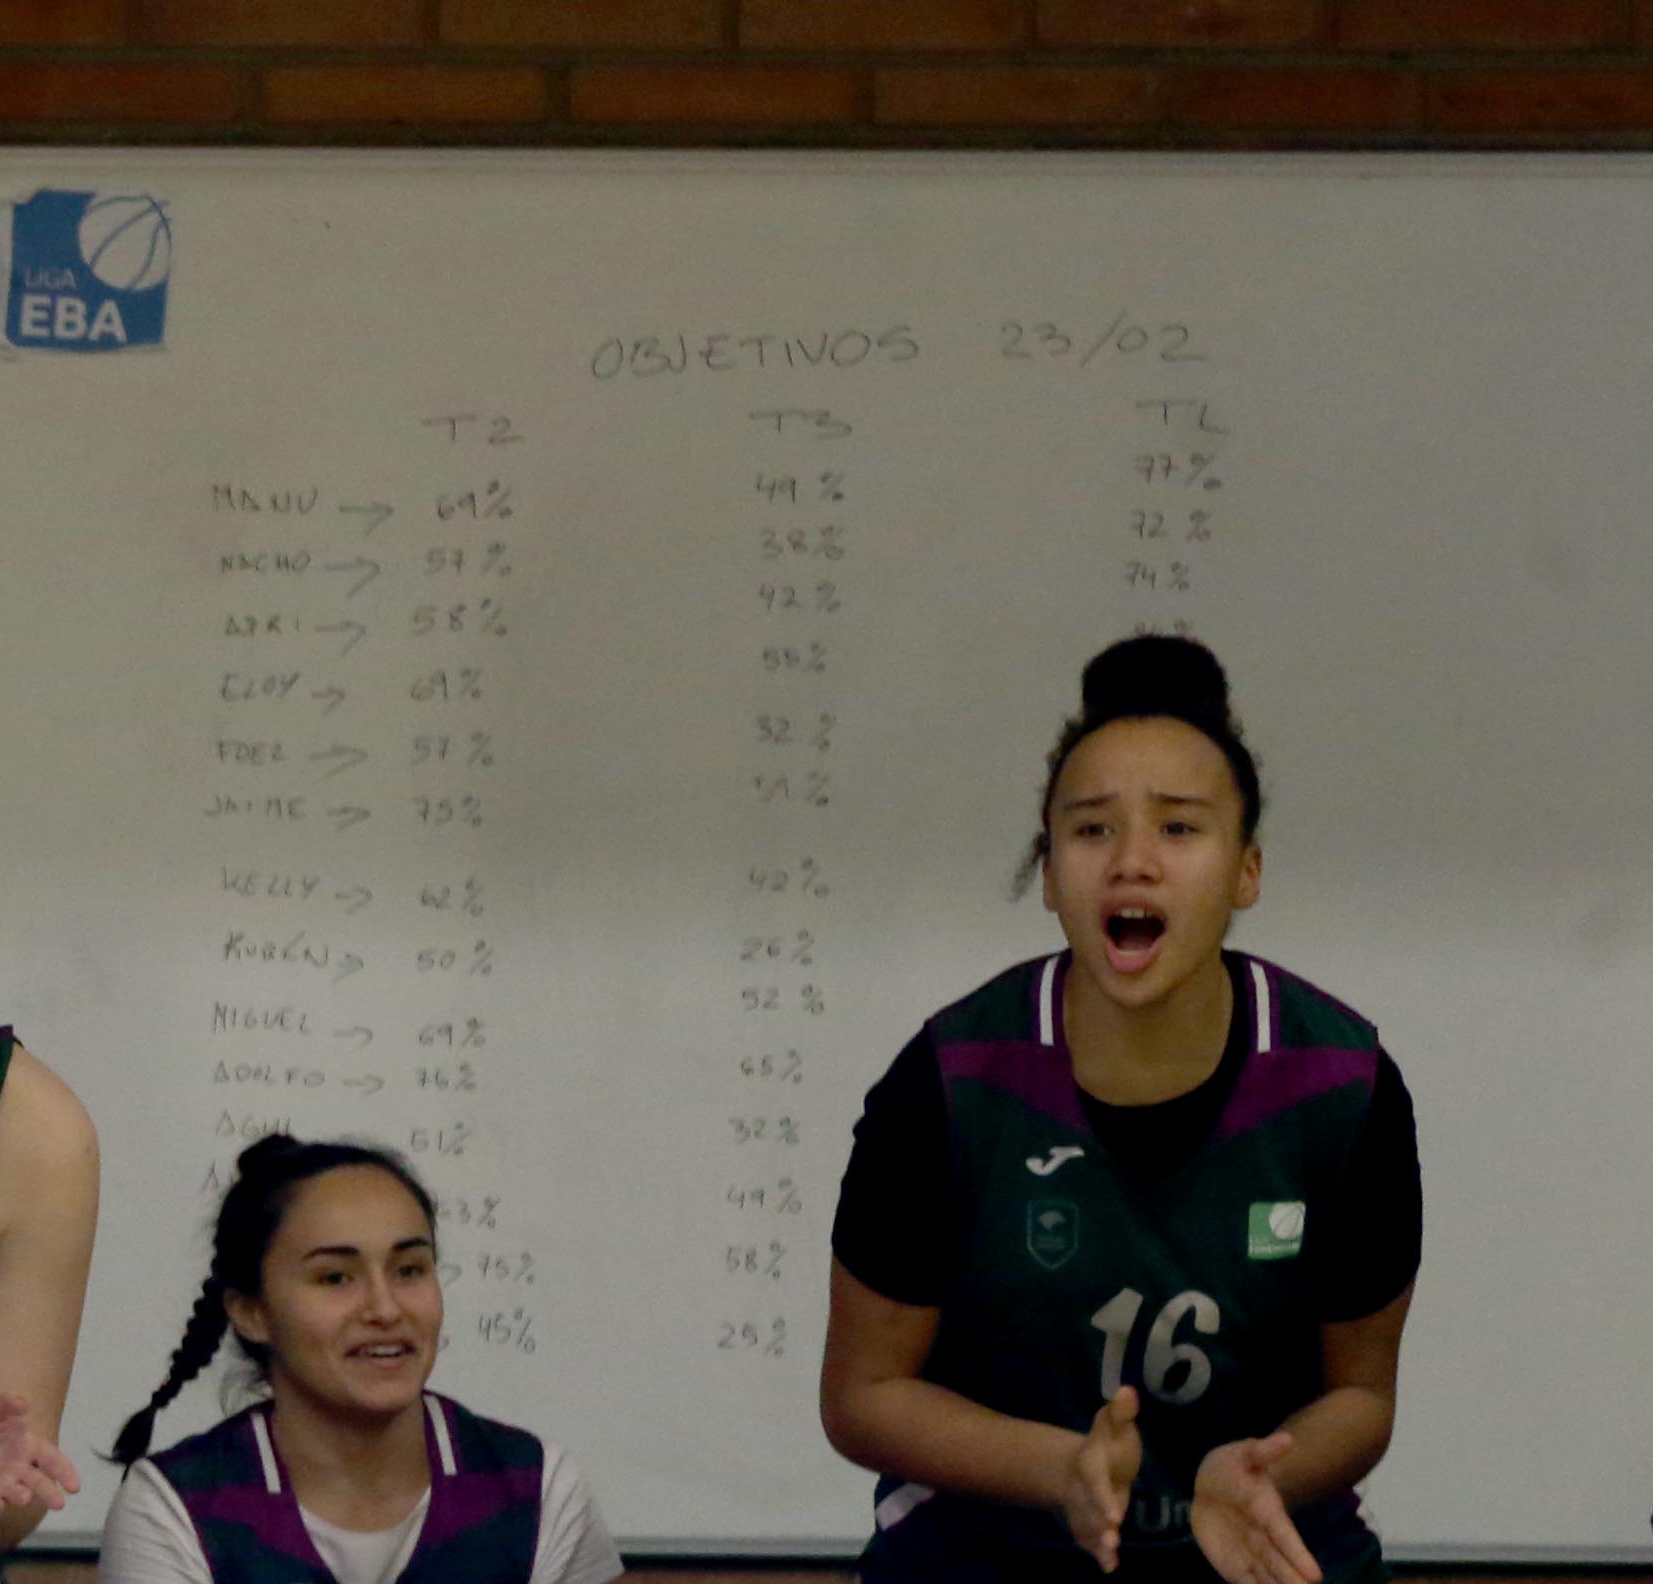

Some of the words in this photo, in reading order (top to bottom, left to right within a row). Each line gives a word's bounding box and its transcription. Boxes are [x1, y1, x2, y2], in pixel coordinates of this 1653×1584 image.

[20, 293, 128, 343] EBA
[591, 324, 920, 381] OBJETIVOS
[999, 310, 1210, 368] 23/02
[1089, 1286, 1223, 1406] 16
